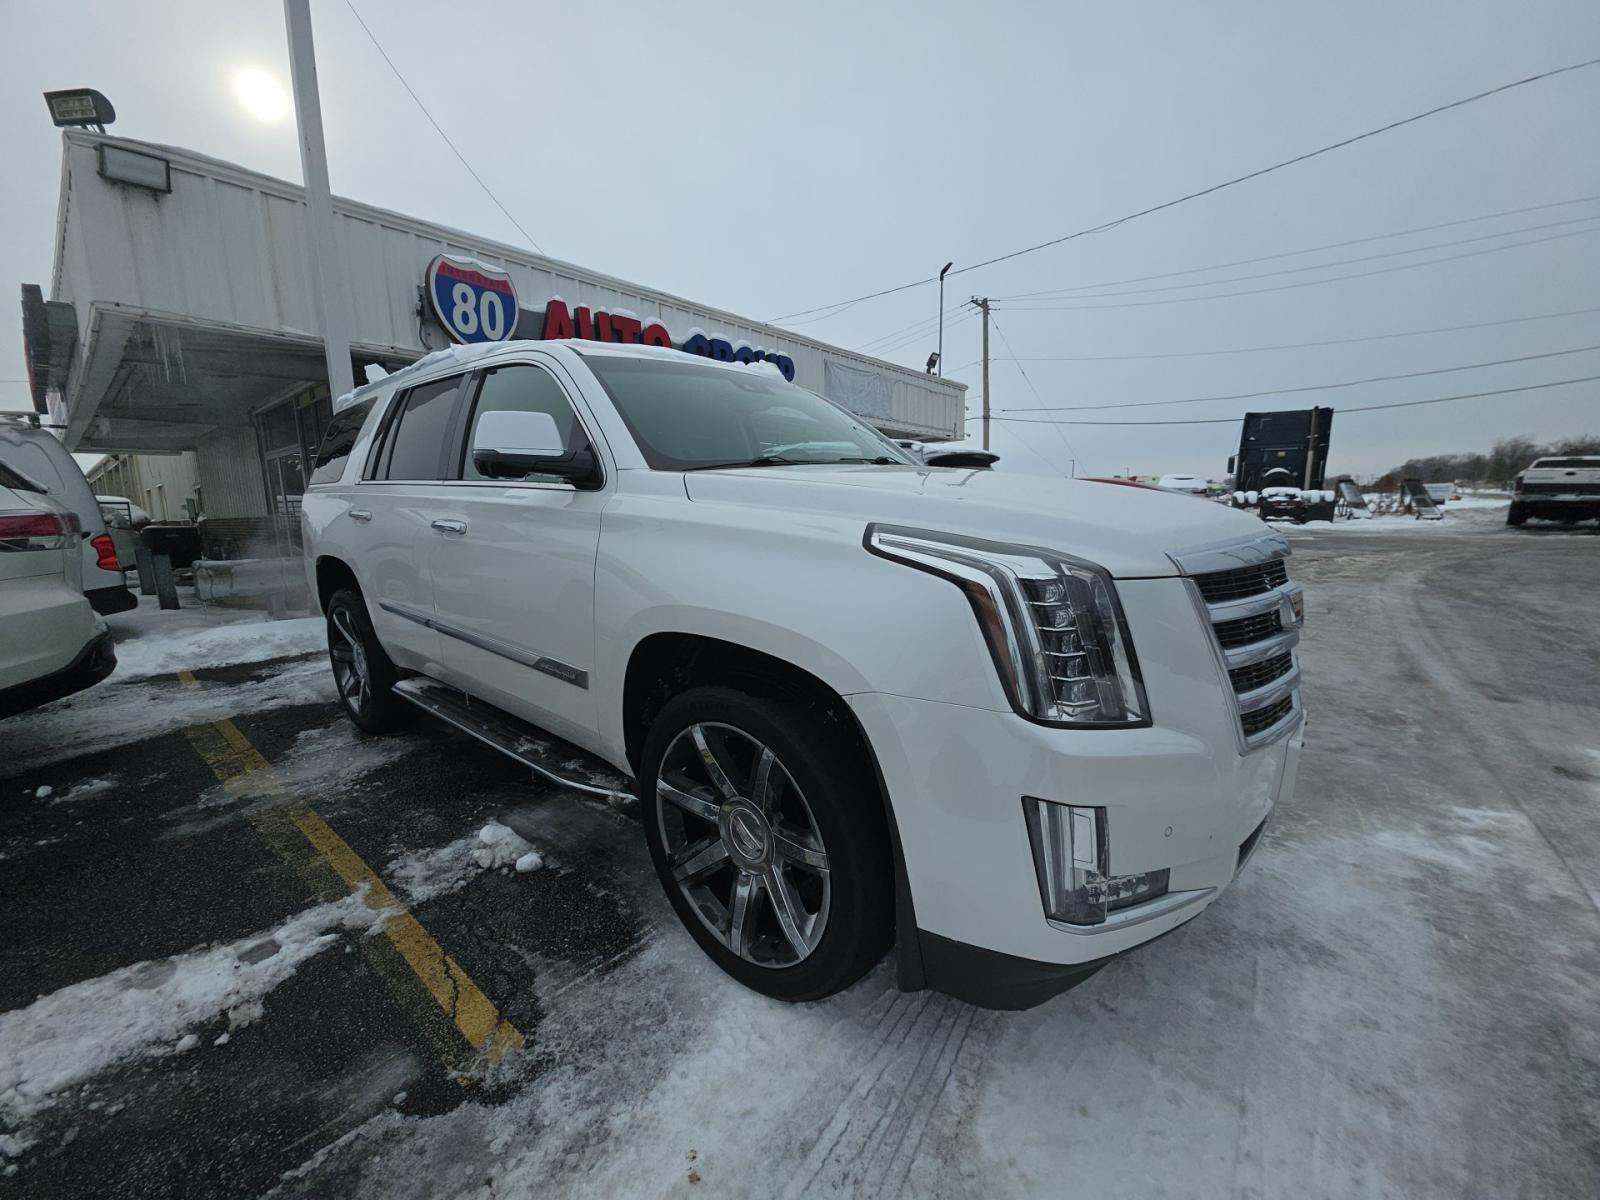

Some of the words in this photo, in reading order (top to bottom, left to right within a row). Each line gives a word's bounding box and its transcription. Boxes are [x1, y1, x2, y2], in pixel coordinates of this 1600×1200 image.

[452, 282, 504, 341] 80
[542, 299, 673, 348] AUTO
[683, 333, 795, 382] GROP
